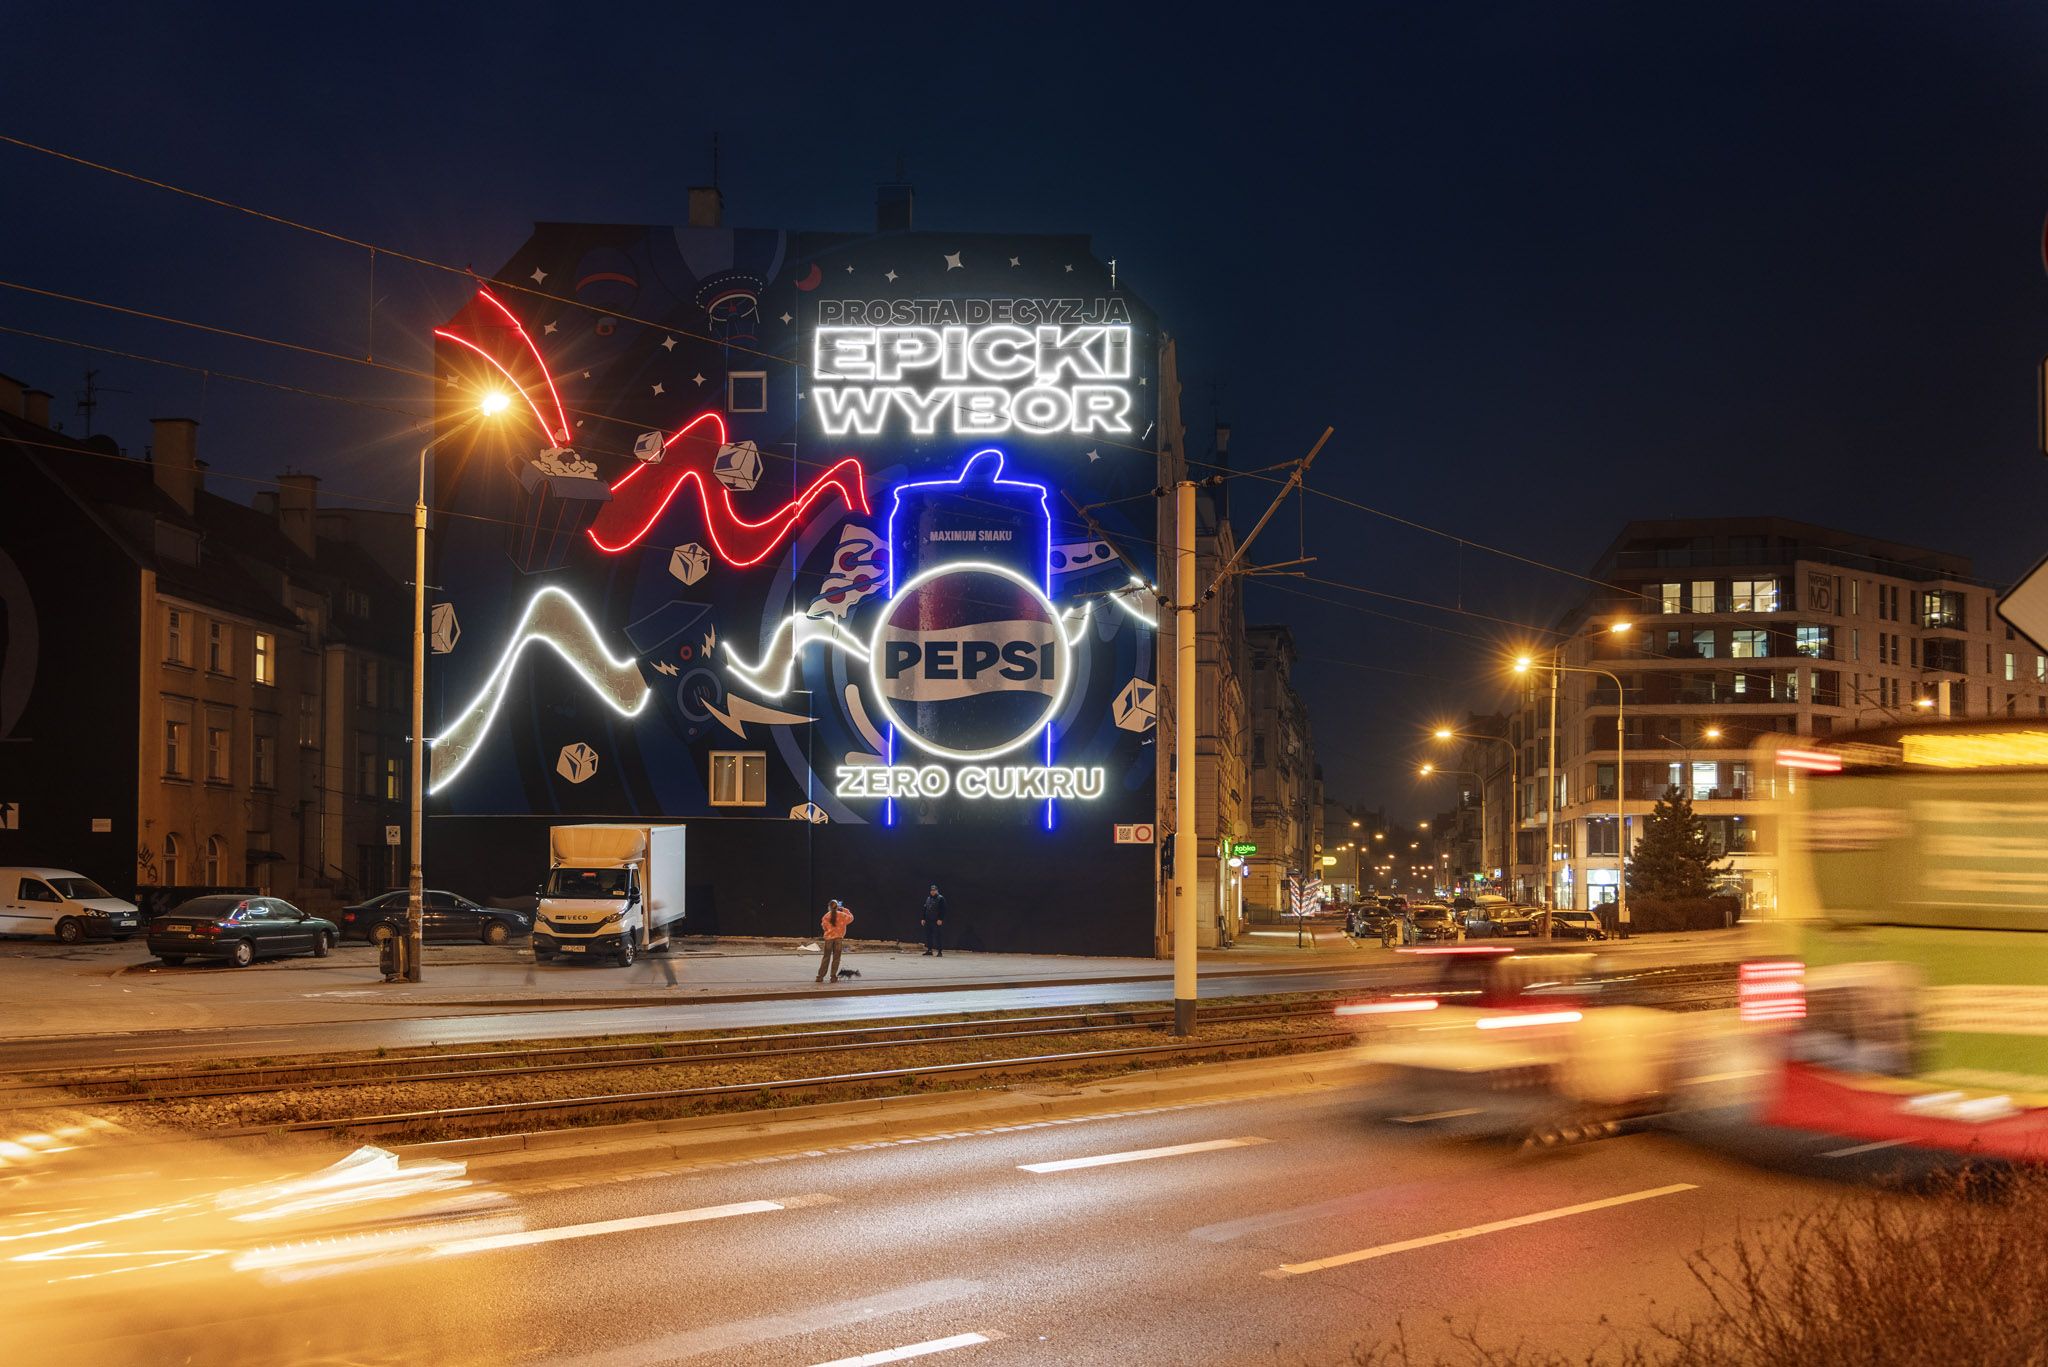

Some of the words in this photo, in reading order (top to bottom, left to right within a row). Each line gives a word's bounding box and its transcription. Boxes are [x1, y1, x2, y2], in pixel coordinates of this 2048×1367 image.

[818, 299, 961, 326] PROSTA
[965, 297, 1131, 325] DECYZJA
[814, 325, 1131, 381] EPICKI
[812, 375, 1132, 435] WYBÓR
[930, 530, 977, 541] MAXIMUM
[978, 530, 1012, 541] SMAKU
[886, 640, 1055, 681] PEPSI
[836, 764, 949, 798] ZERO
[956, 765, 1104, 799] CUKRU
